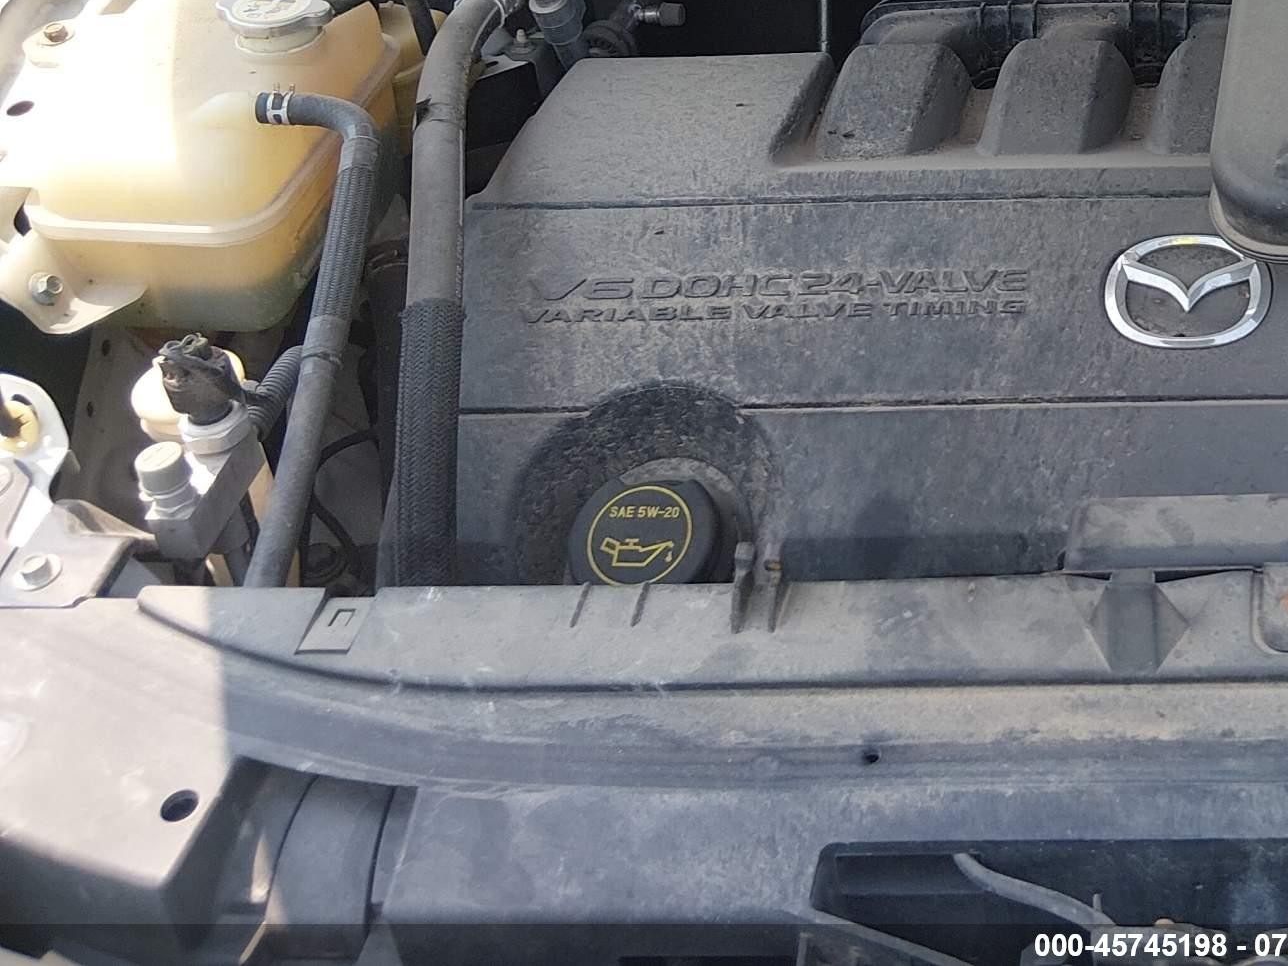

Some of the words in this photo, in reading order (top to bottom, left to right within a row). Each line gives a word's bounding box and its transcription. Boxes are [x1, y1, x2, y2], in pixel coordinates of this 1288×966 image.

[528, 277, 635, 301] V6
[639, 274, 794, 299] DOHC
[798, 269, 1028, 296] 24-VALVE
[519, 306, 731, 324] VARIABLE
[741, 302, 873, 319] VALVE
[883, 300, 1026, 316] TIMING
[609, 506, 634, 518] SAE
[637, 506, 680, 518] 5W-20
